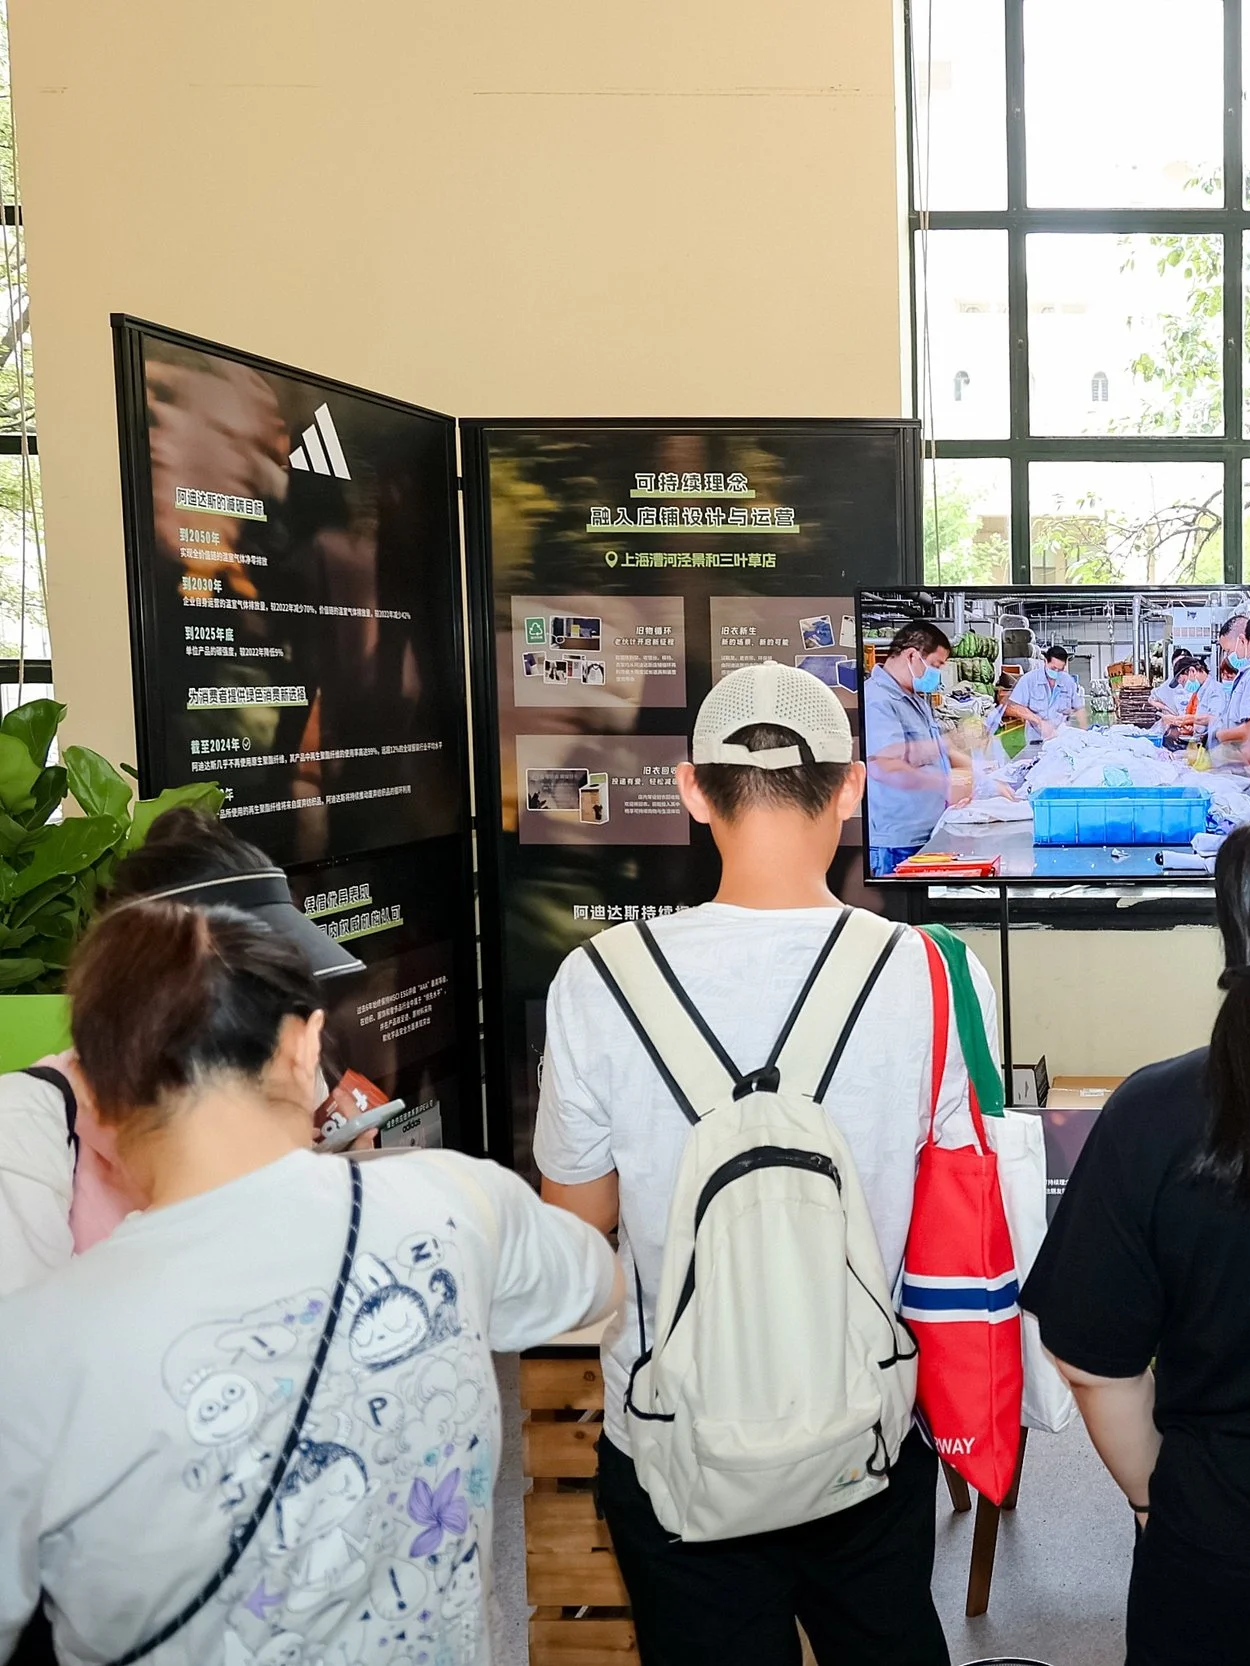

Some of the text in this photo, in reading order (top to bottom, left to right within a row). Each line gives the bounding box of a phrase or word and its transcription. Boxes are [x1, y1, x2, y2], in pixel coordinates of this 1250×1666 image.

[635, 472, 748, 493] 可持续理念
[175, 487, 265, 516] 阿迪达斯的减碳目标
[590, 506, 796, 528] 融入店铺设计与运营
[179, 528, 220, 546] 到2050年
[621, 553, 776, 569] 上海漕河泾景和三叶草店
[182, 576, 222, 593] 到2030年
[185, 626, 234, 641] 到2025年底
[636, 627, 672, 635] 旧物循环
[721, 627, 757, 636] 旧衣新生
[188, 686, 306, 705] 为消费者提供绿色消费新选择
[190, 738, 240, 755] 截至2024年
[304, 883, 370, 916] 凭借优异表现
[573, 905, 698, 921] 阿迪达斯持续
